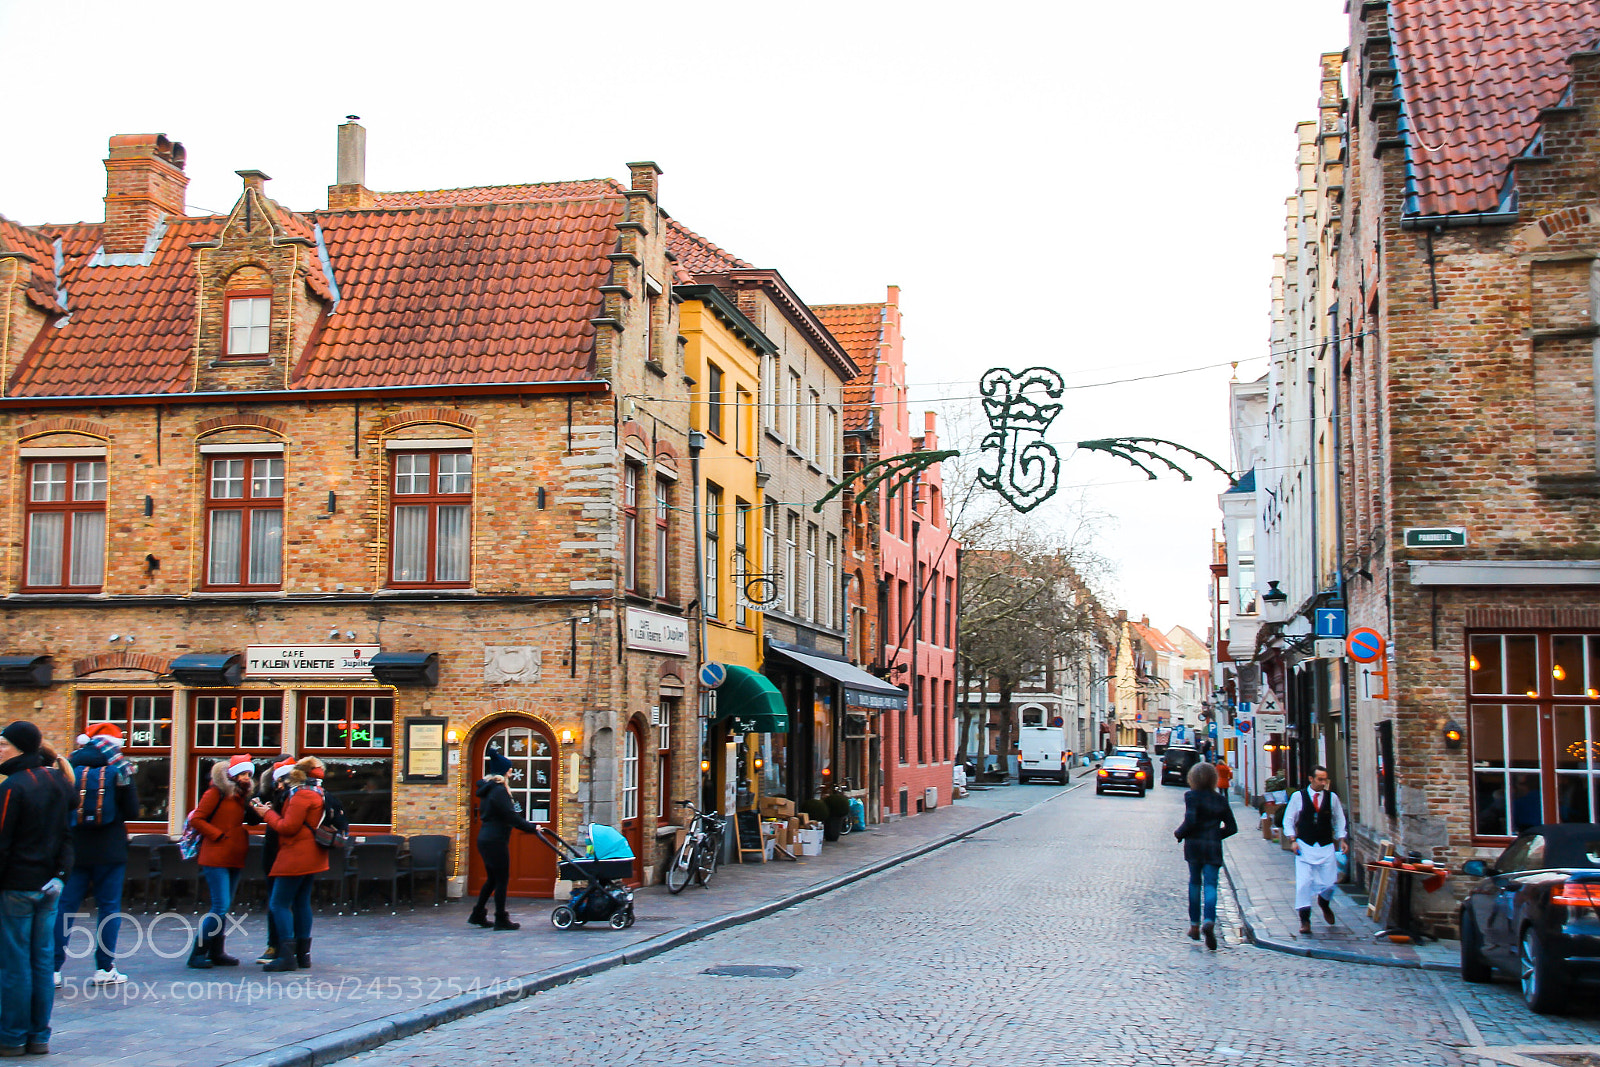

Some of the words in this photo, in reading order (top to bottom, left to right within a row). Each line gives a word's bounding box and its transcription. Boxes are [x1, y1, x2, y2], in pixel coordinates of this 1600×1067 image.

[282, 650, 305, 658] CAFE
[250, 659, 259, 669] 'T
[261, 659, 290, 669] KLEIN
[294, 659, 335, 669] VENETIE
